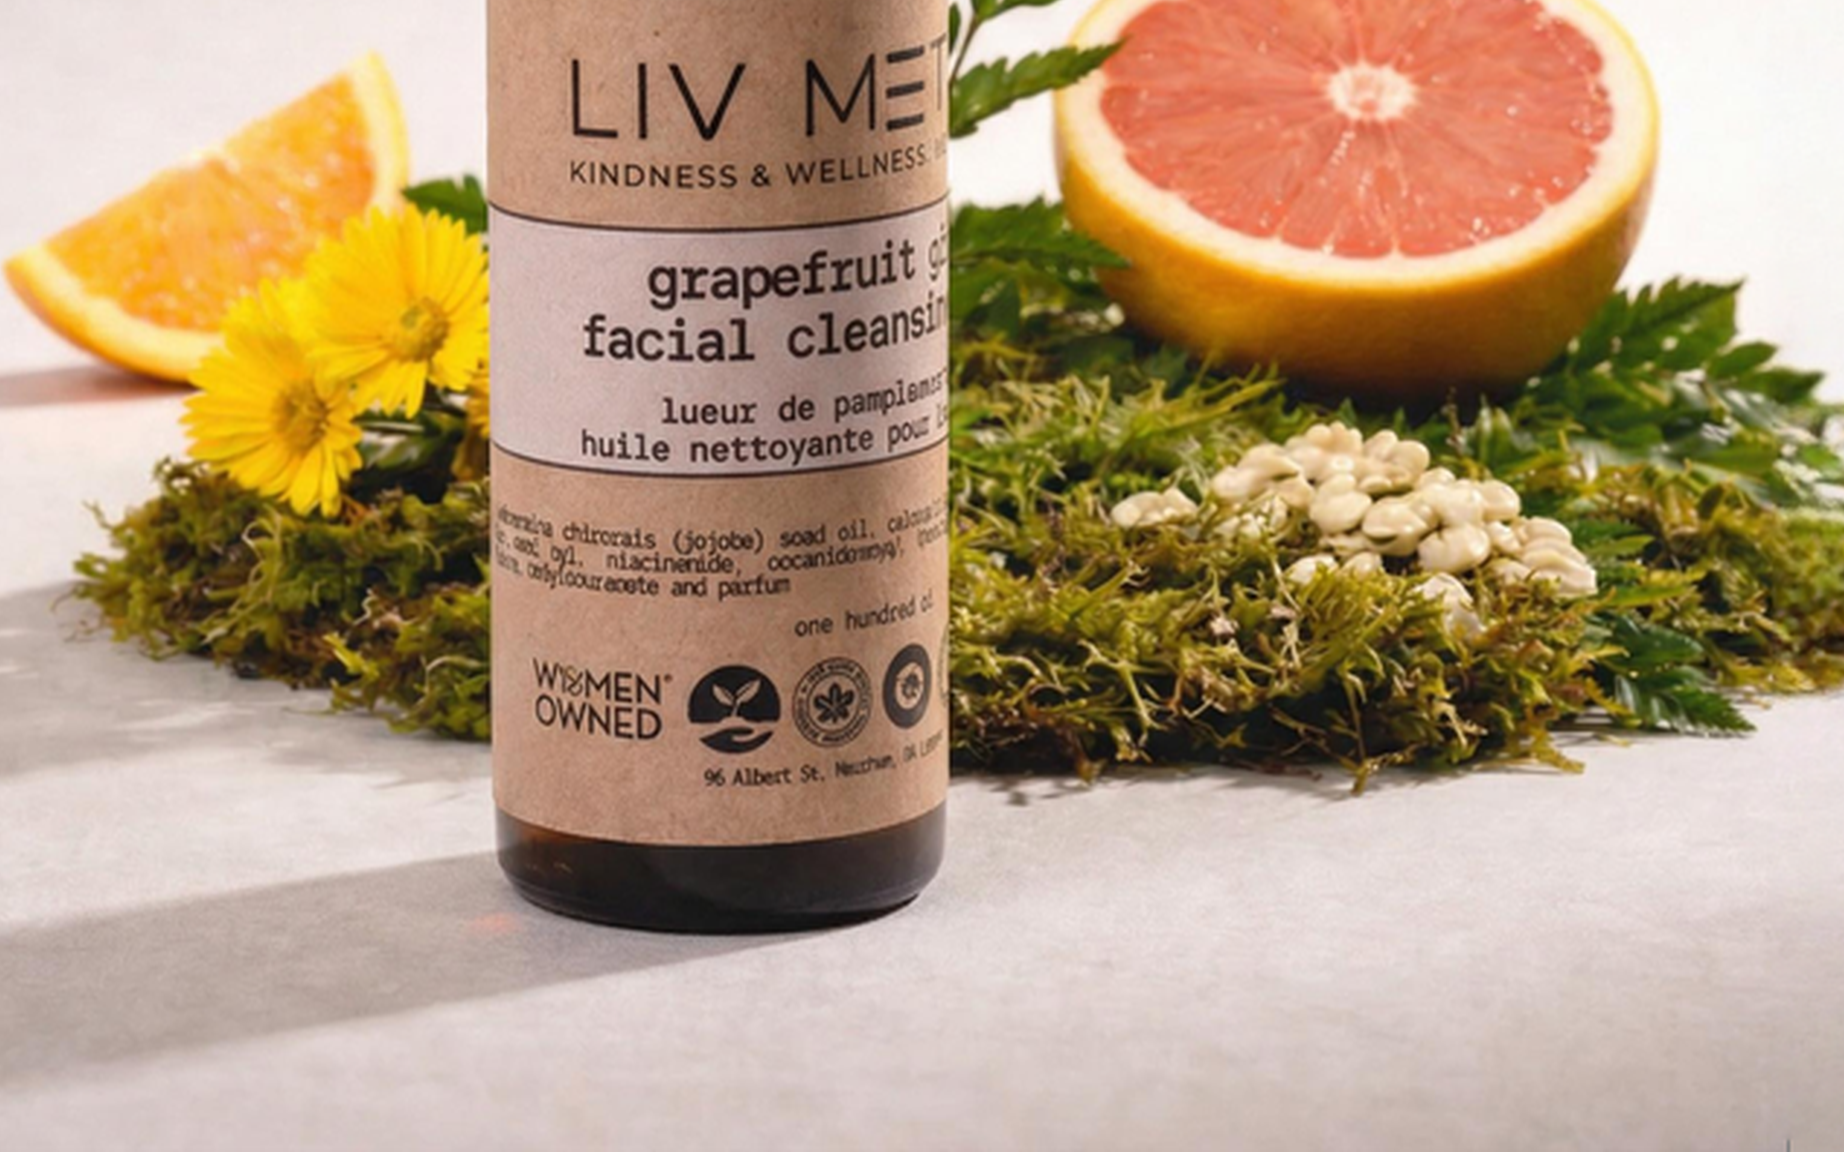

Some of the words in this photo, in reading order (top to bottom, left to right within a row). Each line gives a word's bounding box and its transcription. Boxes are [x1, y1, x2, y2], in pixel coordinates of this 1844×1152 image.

[571, 58, 746, 141] LIV
[570, 160, 738, 189] KINDNESS
[751, 165, 771, 188] &
[648, 239, 916, 310] grapefruit
[583, 314, 756, 363] facial
[661, 397, 757, 425] lueur
[778, 395, 815, 421] de
[581, 429, 671, 462] huile
[689, 427, 874, 466] nettoyante
[670, 577, 708, 598] and
[717, 575, 792, 603] parfum
[794, 616, 834, 638] one
[845, 592, 916, 631] hundred
[535, 693, 662, 741] OWNED
[703, 767, 725, 787] 96
[733, 767, 792, 787] Albert
